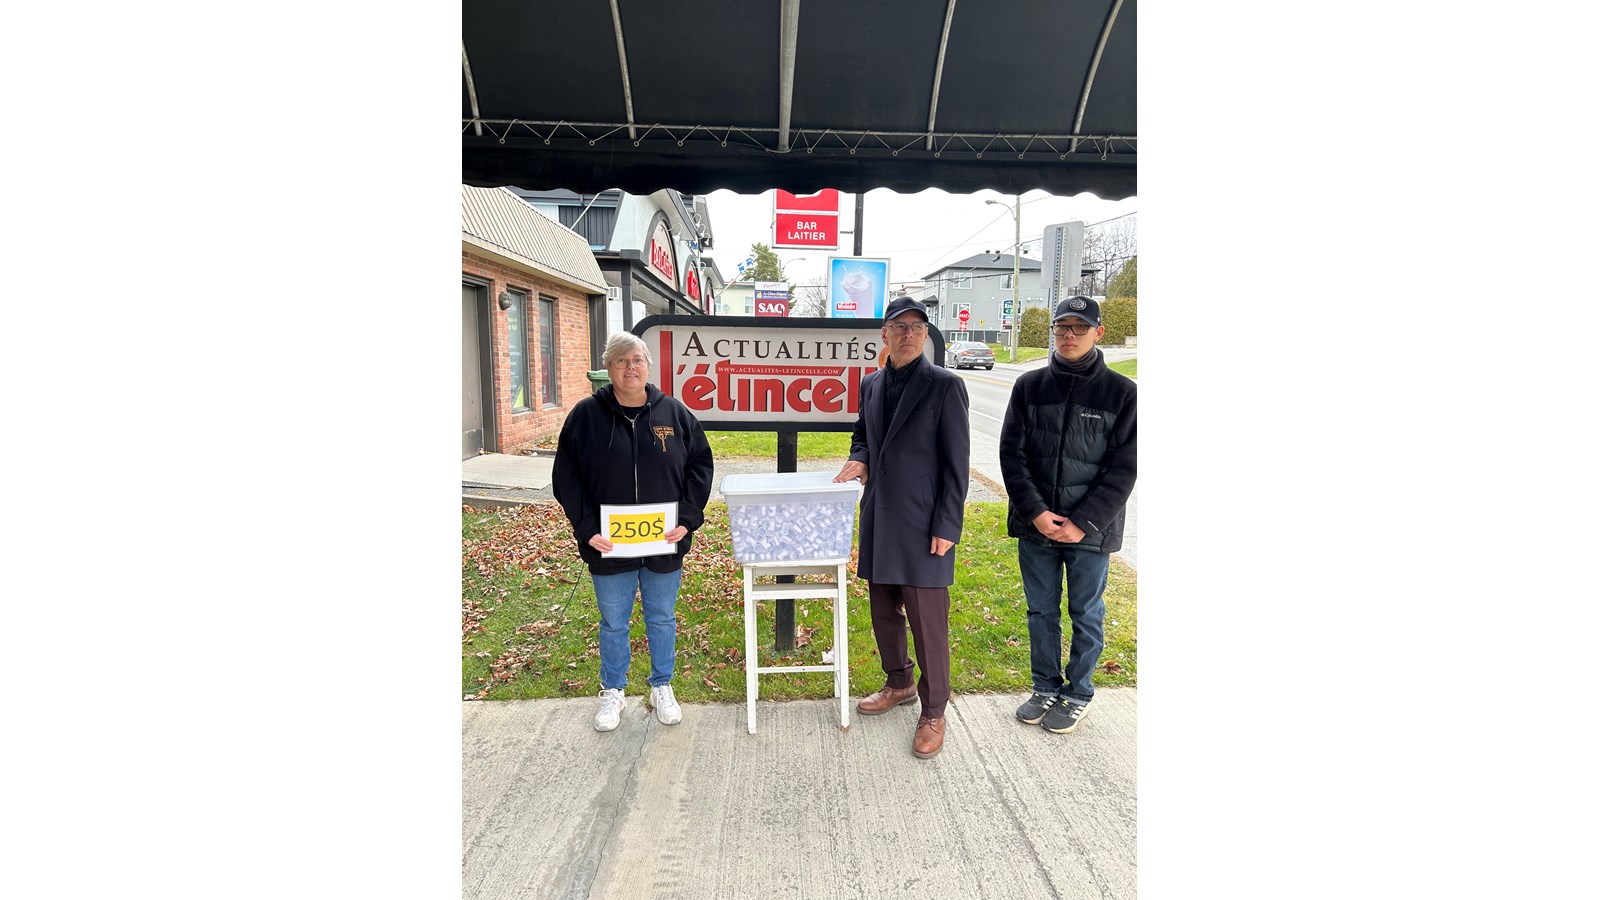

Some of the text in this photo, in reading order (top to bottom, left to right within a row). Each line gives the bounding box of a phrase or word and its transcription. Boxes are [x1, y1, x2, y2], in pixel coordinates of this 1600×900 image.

[797, 221, 817, 230] BAR
[788, 231, 826, 241] LAITIER
[681, 331, 878, 361] ACTUALITÉS
[610, 517, 664, 539] 250$
